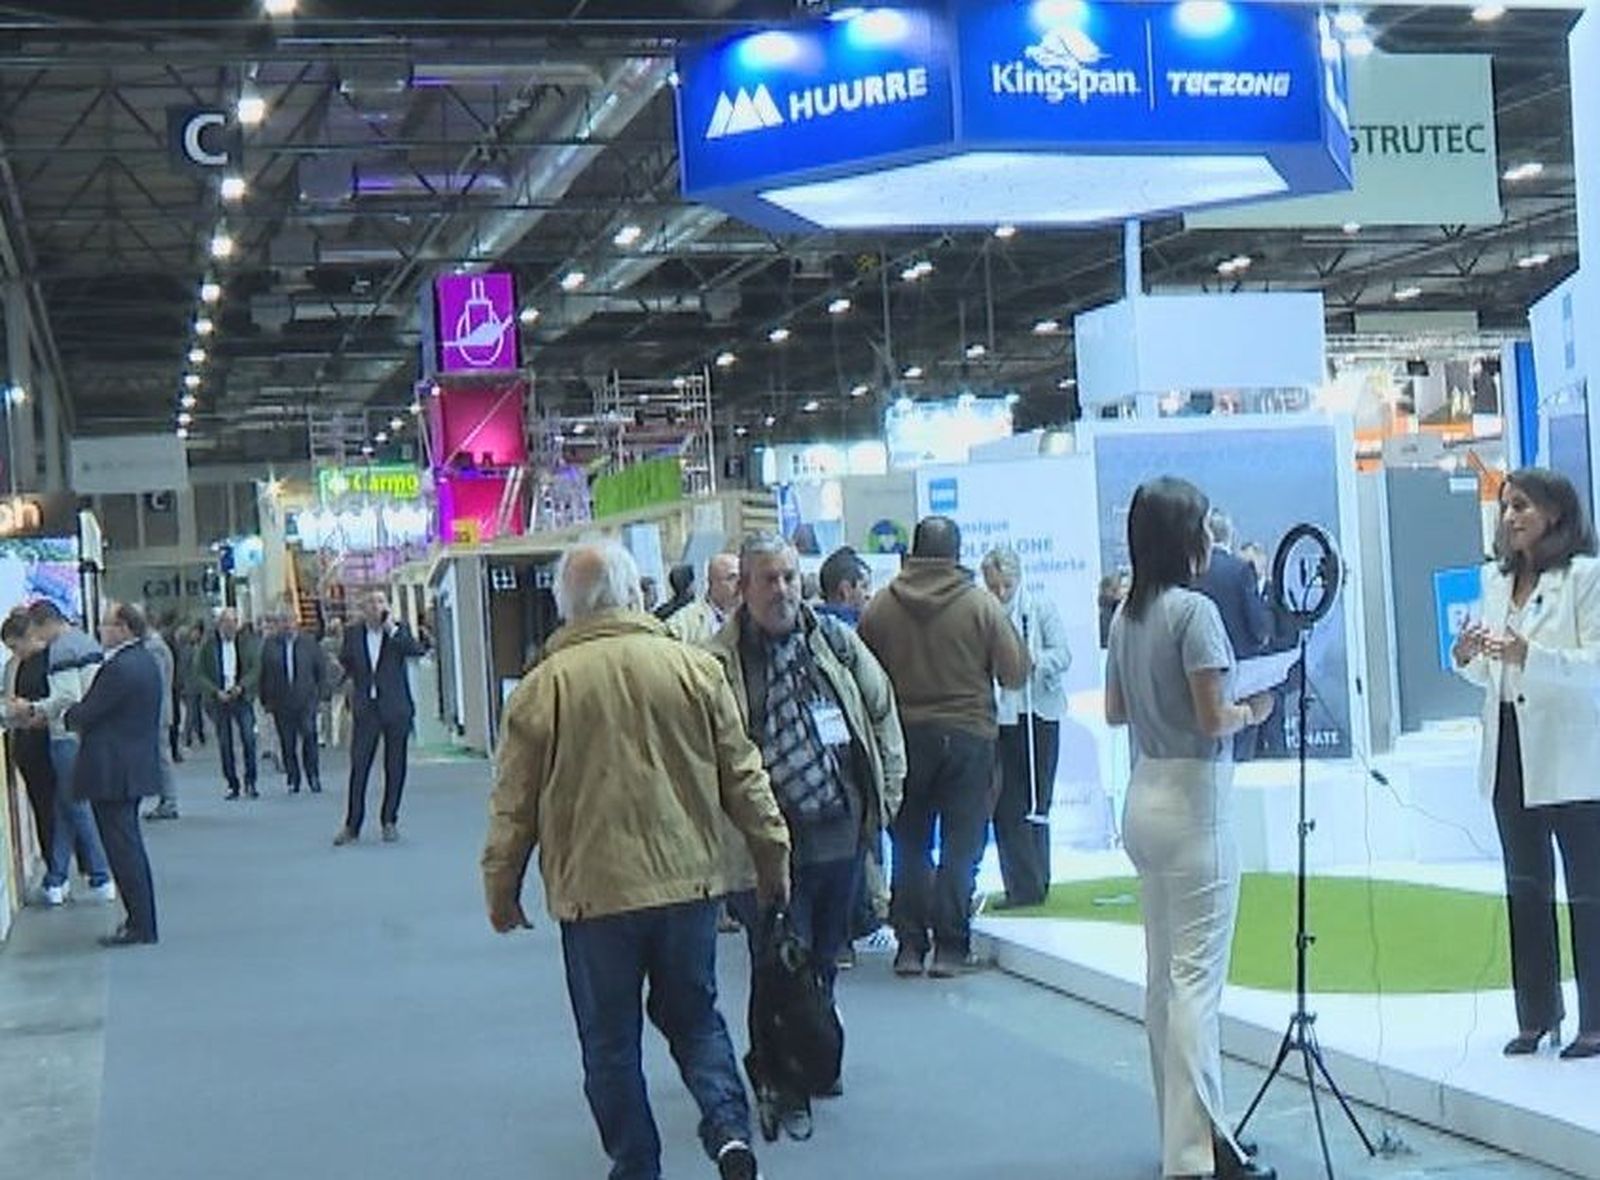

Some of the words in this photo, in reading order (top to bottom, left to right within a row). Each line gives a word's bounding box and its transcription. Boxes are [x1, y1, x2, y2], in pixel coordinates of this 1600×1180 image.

[788, 67, 927, 122] HUURRE
[991, 61, 1138, 104] Kingspan
[184, 112, 229, 166] C
